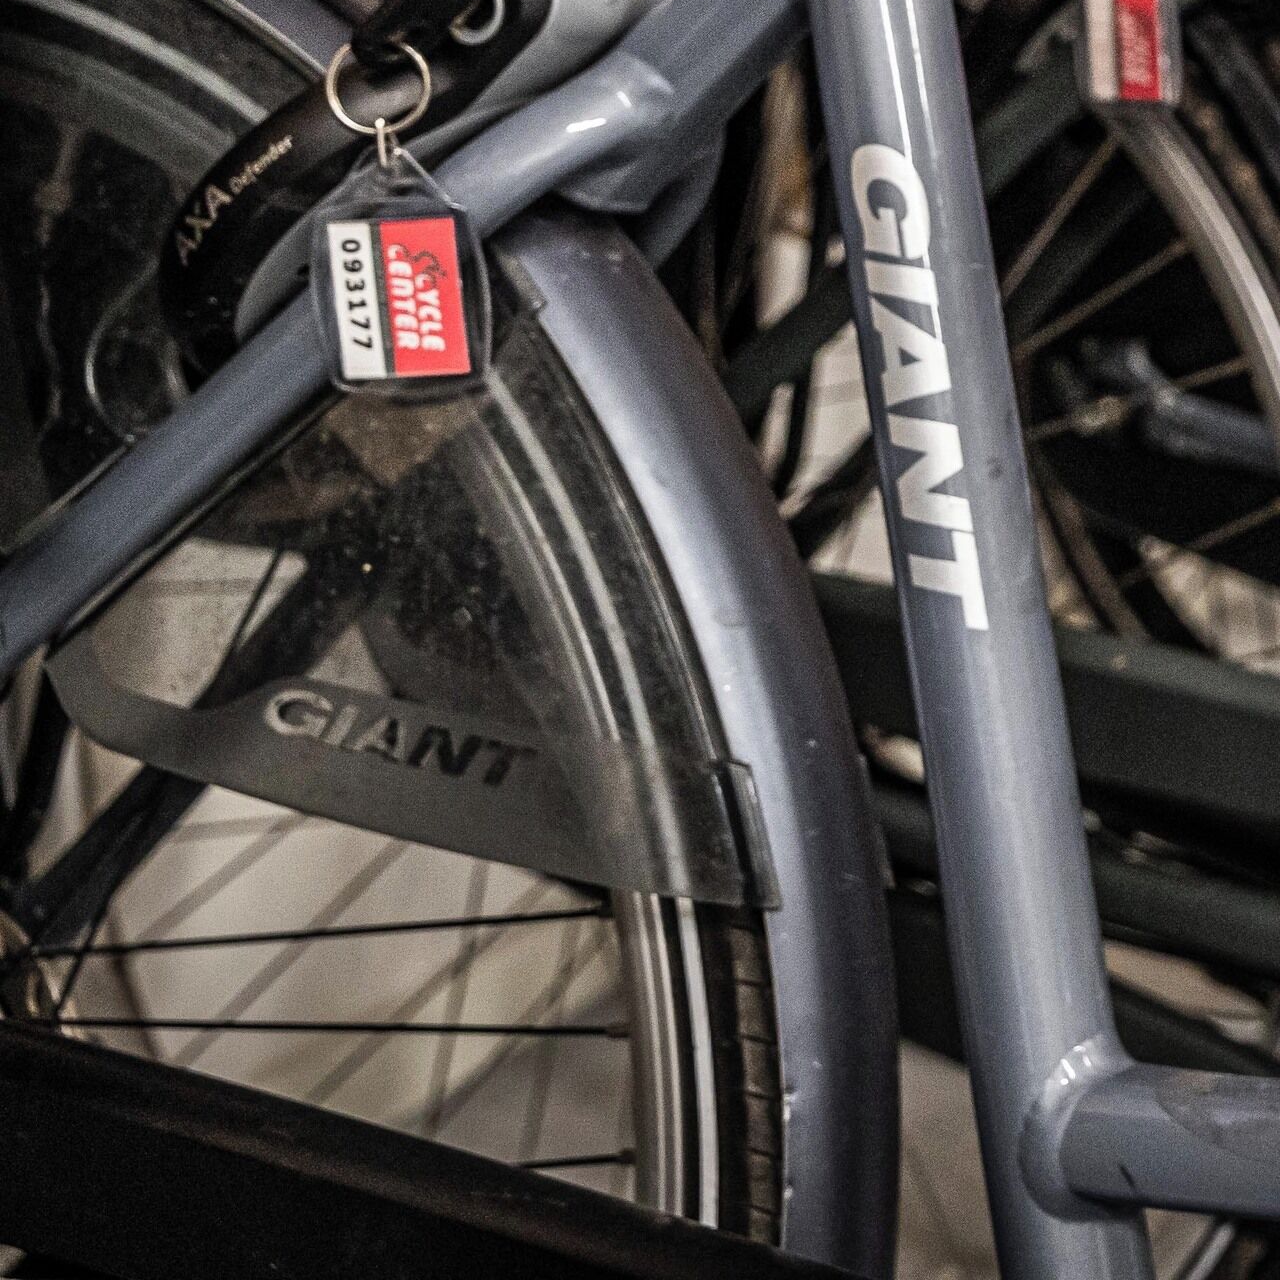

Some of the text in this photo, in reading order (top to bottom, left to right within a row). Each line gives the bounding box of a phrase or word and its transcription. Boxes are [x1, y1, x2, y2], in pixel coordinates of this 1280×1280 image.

[174, 185, 235, 267] AXA
[341, 238, 374, 352] 093177
[850, 143, 989, 631] GIANT
[263, 688, 540, 787] GIANT
